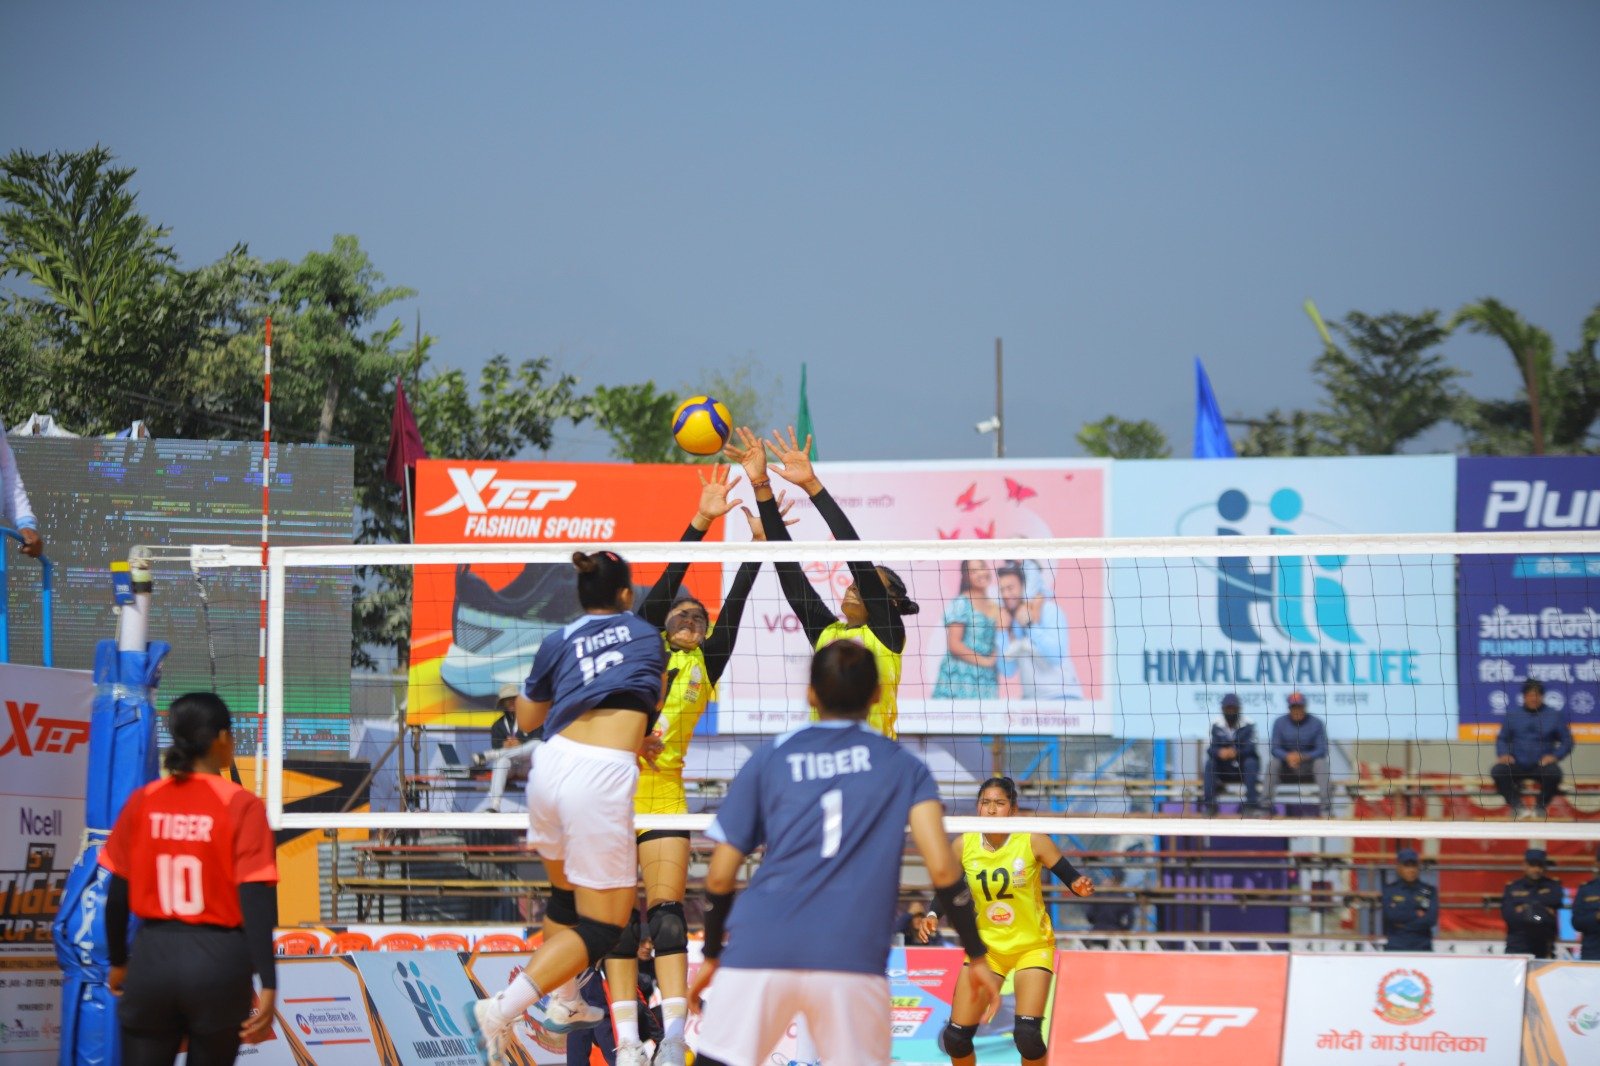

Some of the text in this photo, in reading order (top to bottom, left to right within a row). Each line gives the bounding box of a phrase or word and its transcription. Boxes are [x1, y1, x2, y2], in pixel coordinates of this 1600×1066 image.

[424, 468, 577, 516] XTEP
[464, 515, 615, 540] FASHION SPORTS
[572, 626, 632, 658] TIGER
[0, 701, 91, 757] XTEP
[786, 745, 872, 782] TIGER
[20, 807, 63, 836] Ncell
[148, 812, 214, 843] TIGER
[820, 788, 843, 858] 1
[155, 853, 205, 916] 10
[975, 867, 1015, 901] 12
[1074, 992, 1258, 1043] XTEP
[1317, 1029, 1488, 1054] मोदी गाउँपालिका
